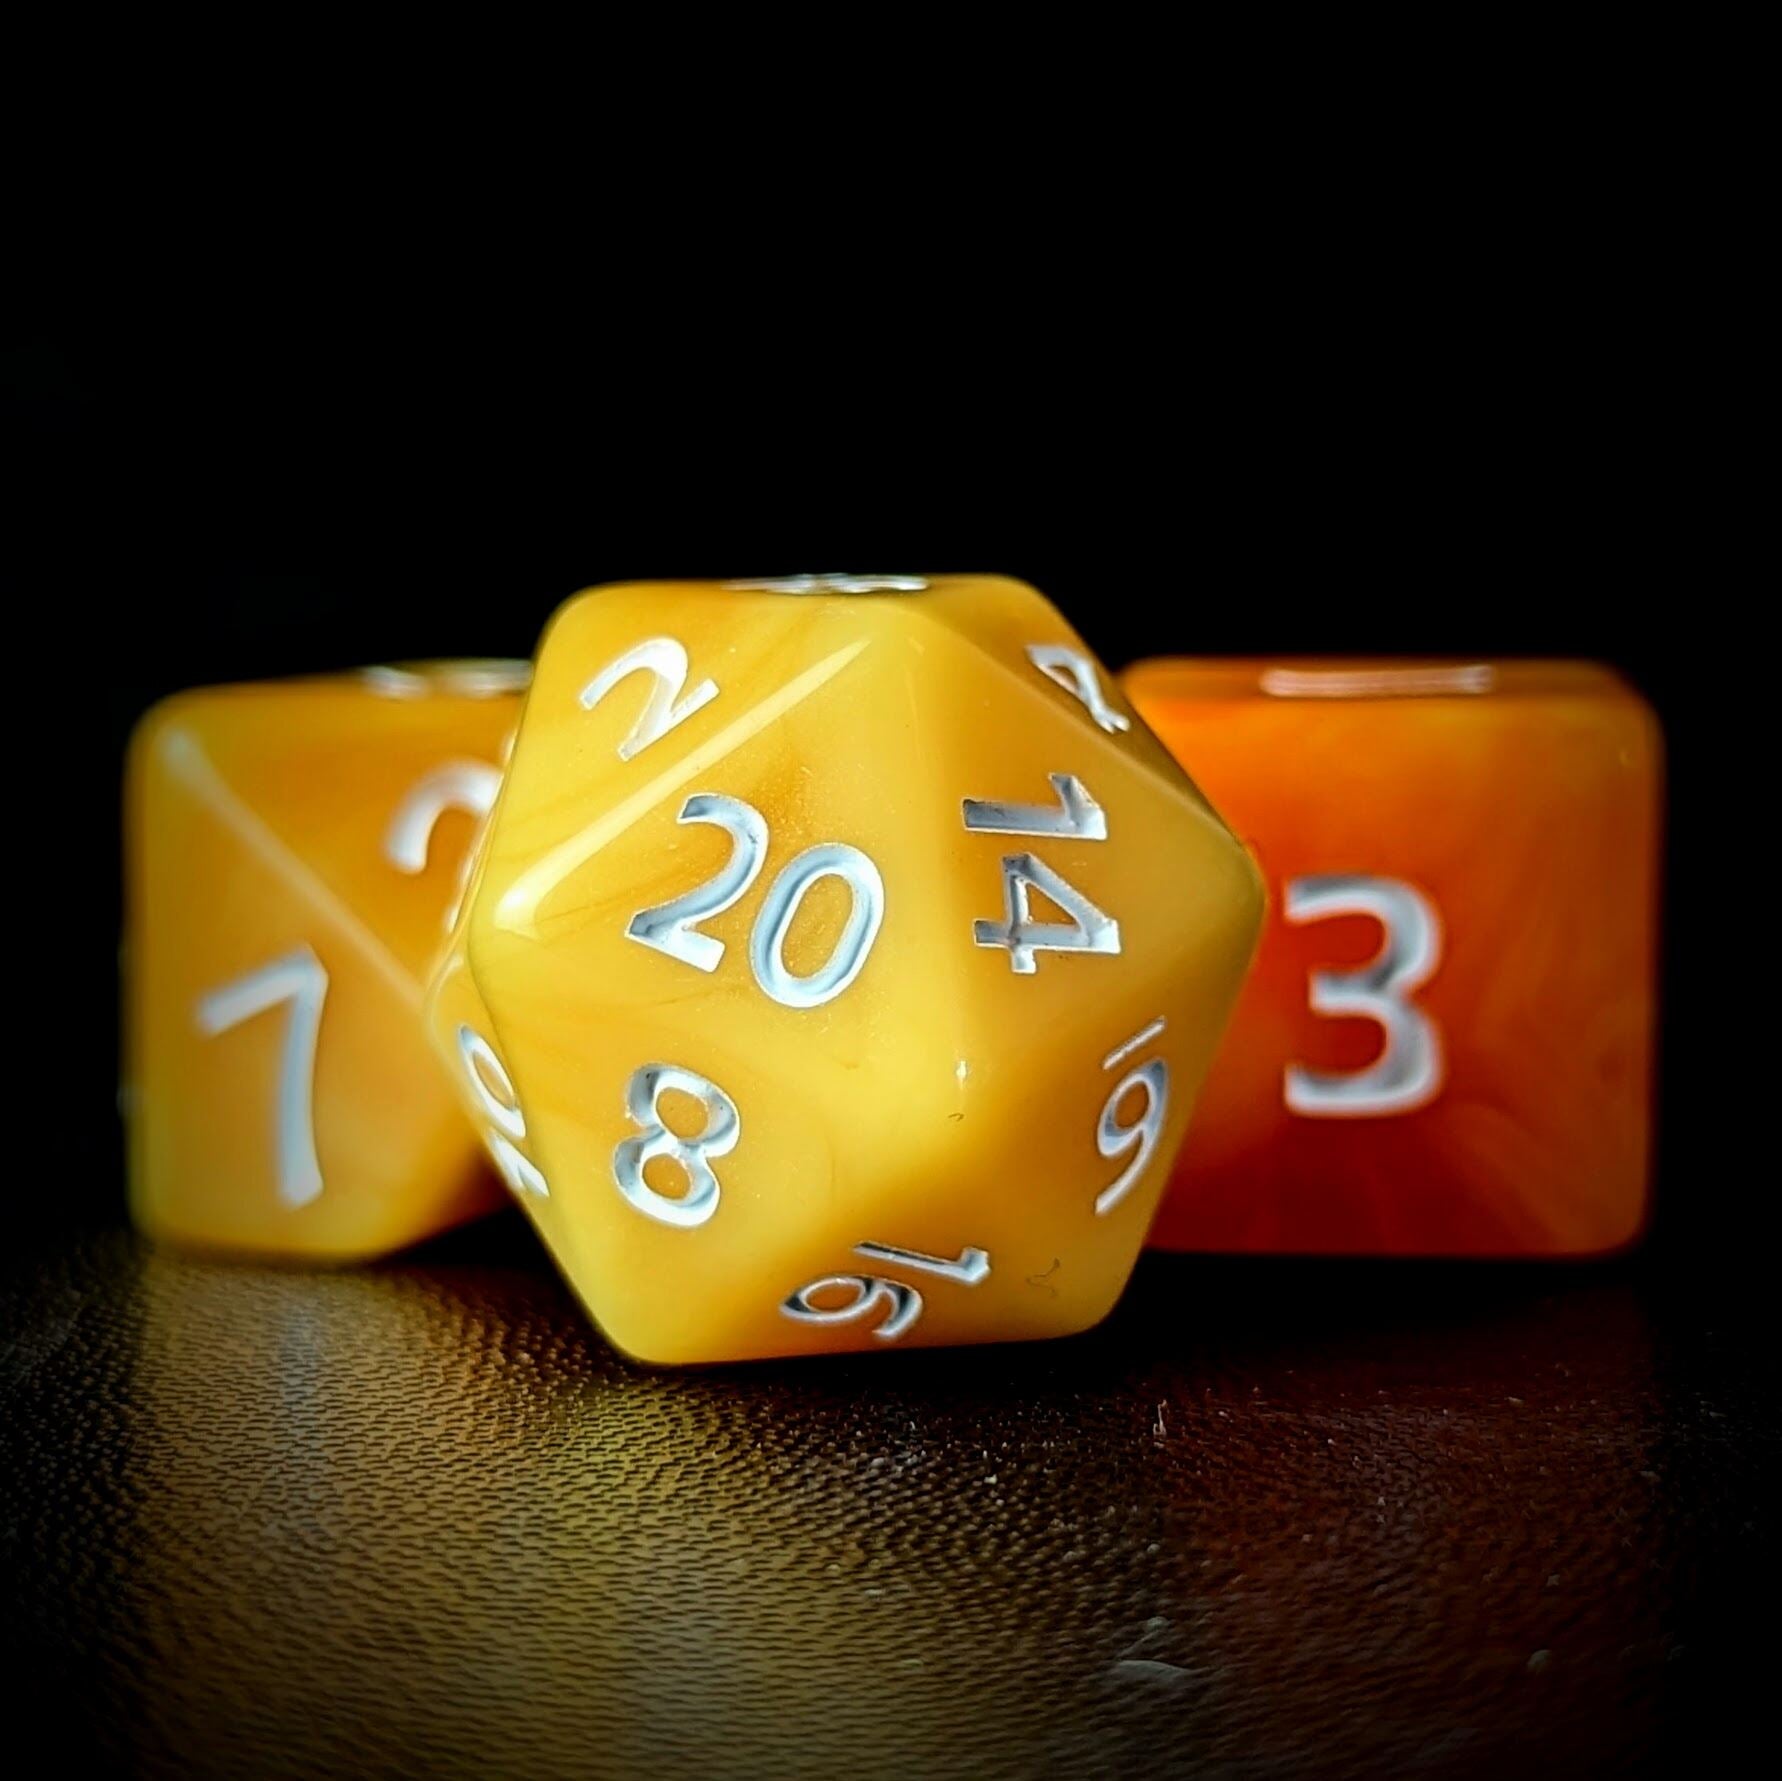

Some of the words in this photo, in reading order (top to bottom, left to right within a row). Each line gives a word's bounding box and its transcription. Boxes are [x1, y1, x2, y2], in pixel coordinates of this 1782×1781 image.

[579, 636, 720, 761] 2
[624, 792, 885, 1008] 20
[962, 773, 1121, 974] 14
[197, 944, 329, 1209] 7
[1283, 873, 1443, 1119] 3
[613, 1062, 741, 1228] 8
[779, 1240, 992, 1340] 16
